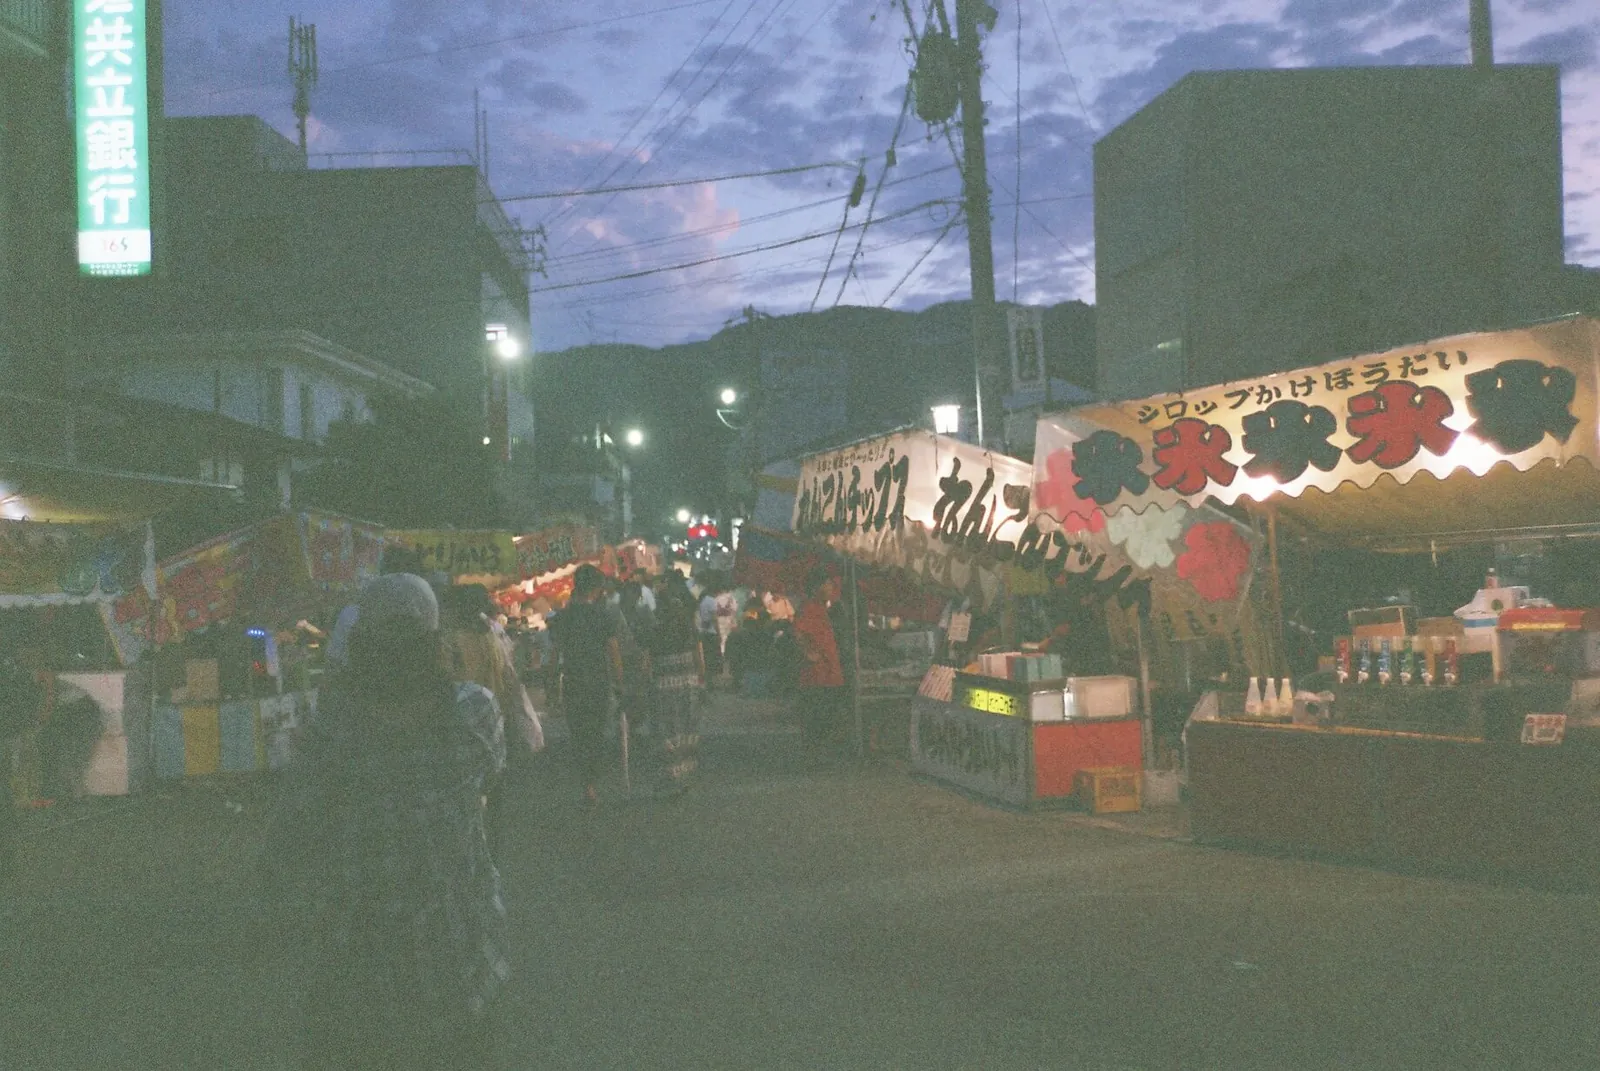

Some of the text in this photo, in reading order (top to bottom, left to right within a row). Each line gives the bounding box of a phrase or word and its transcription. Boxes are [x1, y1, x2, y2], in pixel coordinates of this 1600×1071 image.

[85, 0, 136, 224] 共立銀行
[1137, 350, 1468, 424] シロップかけほうだい
